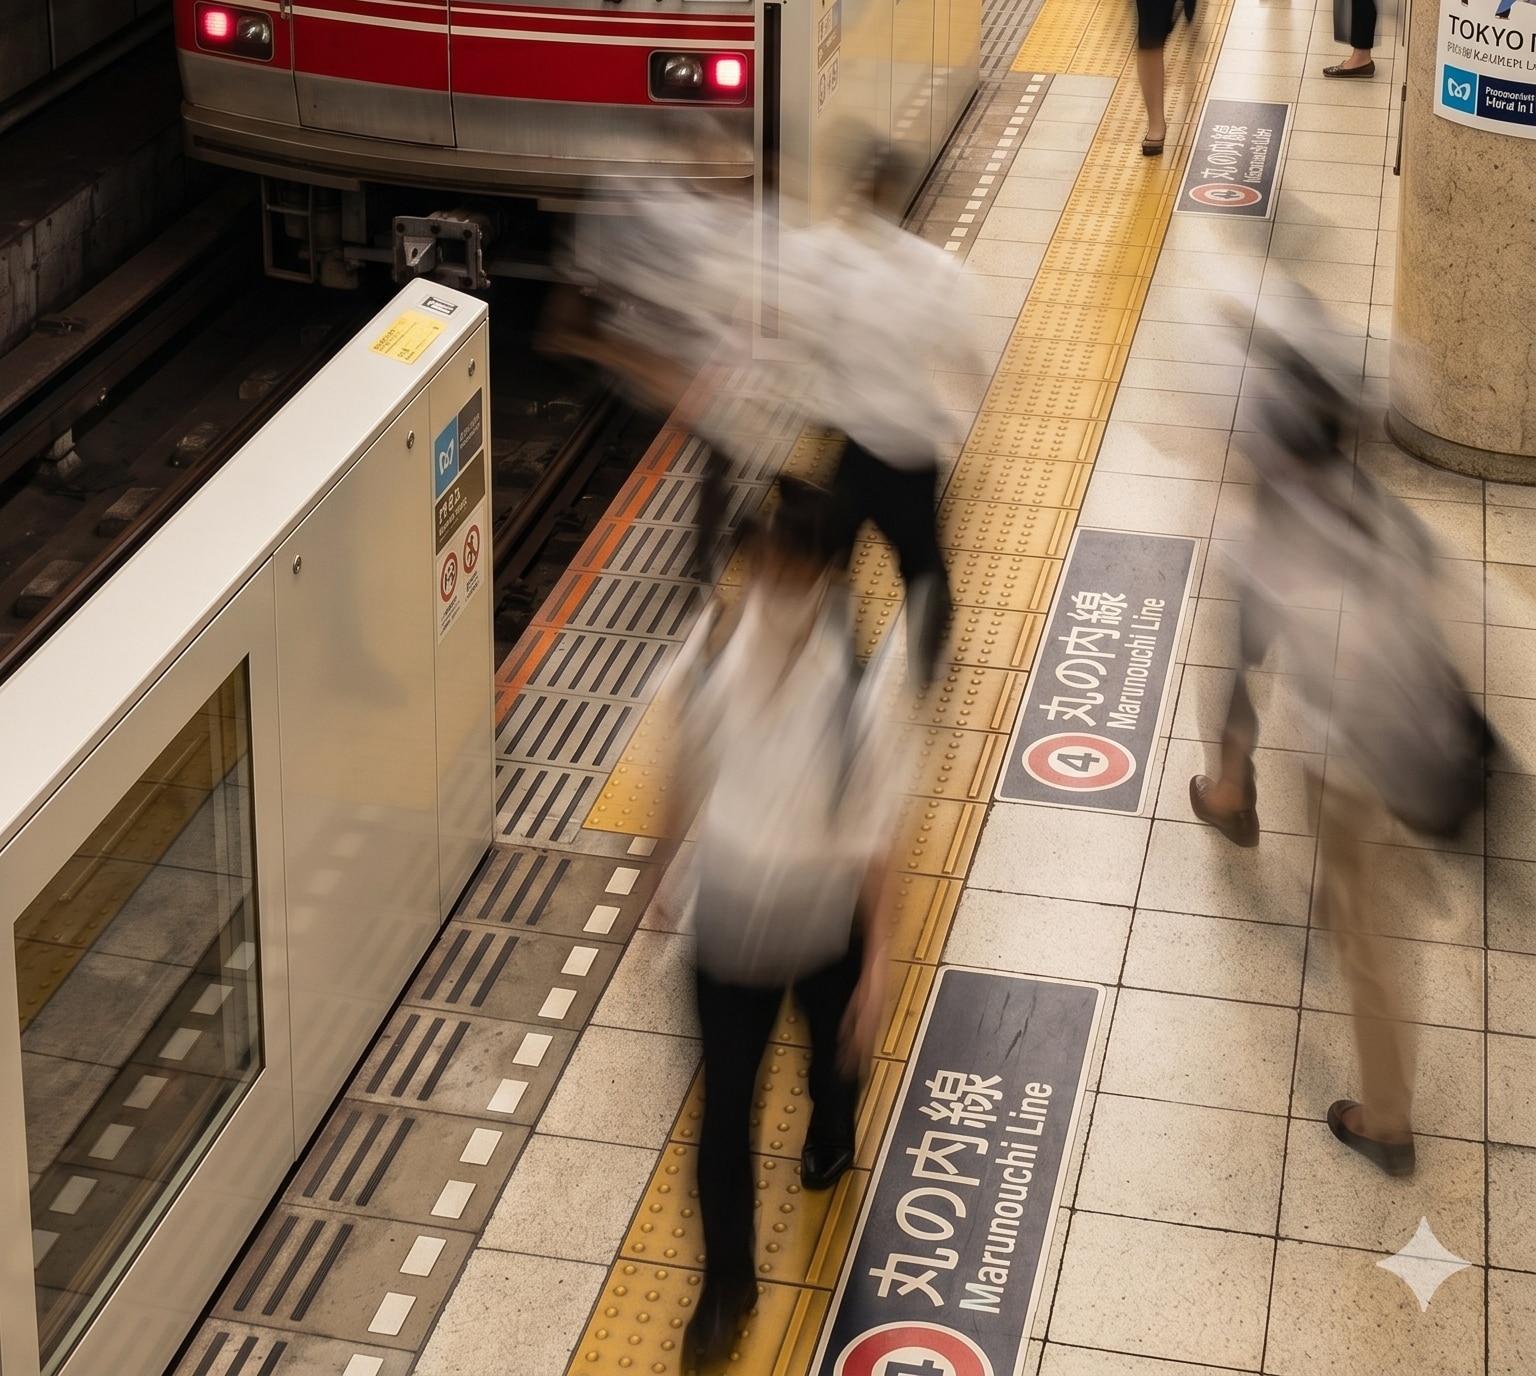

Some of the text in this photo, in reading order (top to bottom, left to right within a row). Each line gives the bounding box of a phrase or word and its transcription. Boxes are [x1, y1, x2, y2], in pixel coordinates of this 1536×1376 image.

[1448, 13, 1524, 51] TOKYO
[1039, 590, 1128, 727] 丸の内線
[1106, 597, 1166, 730] Marunouchi Line
[1056, 752, 1100, 773] 4
[868, 1069, 1003, 1308] 丸の内線
[958, 1081, 1054, 1314] Marunouchi Line
